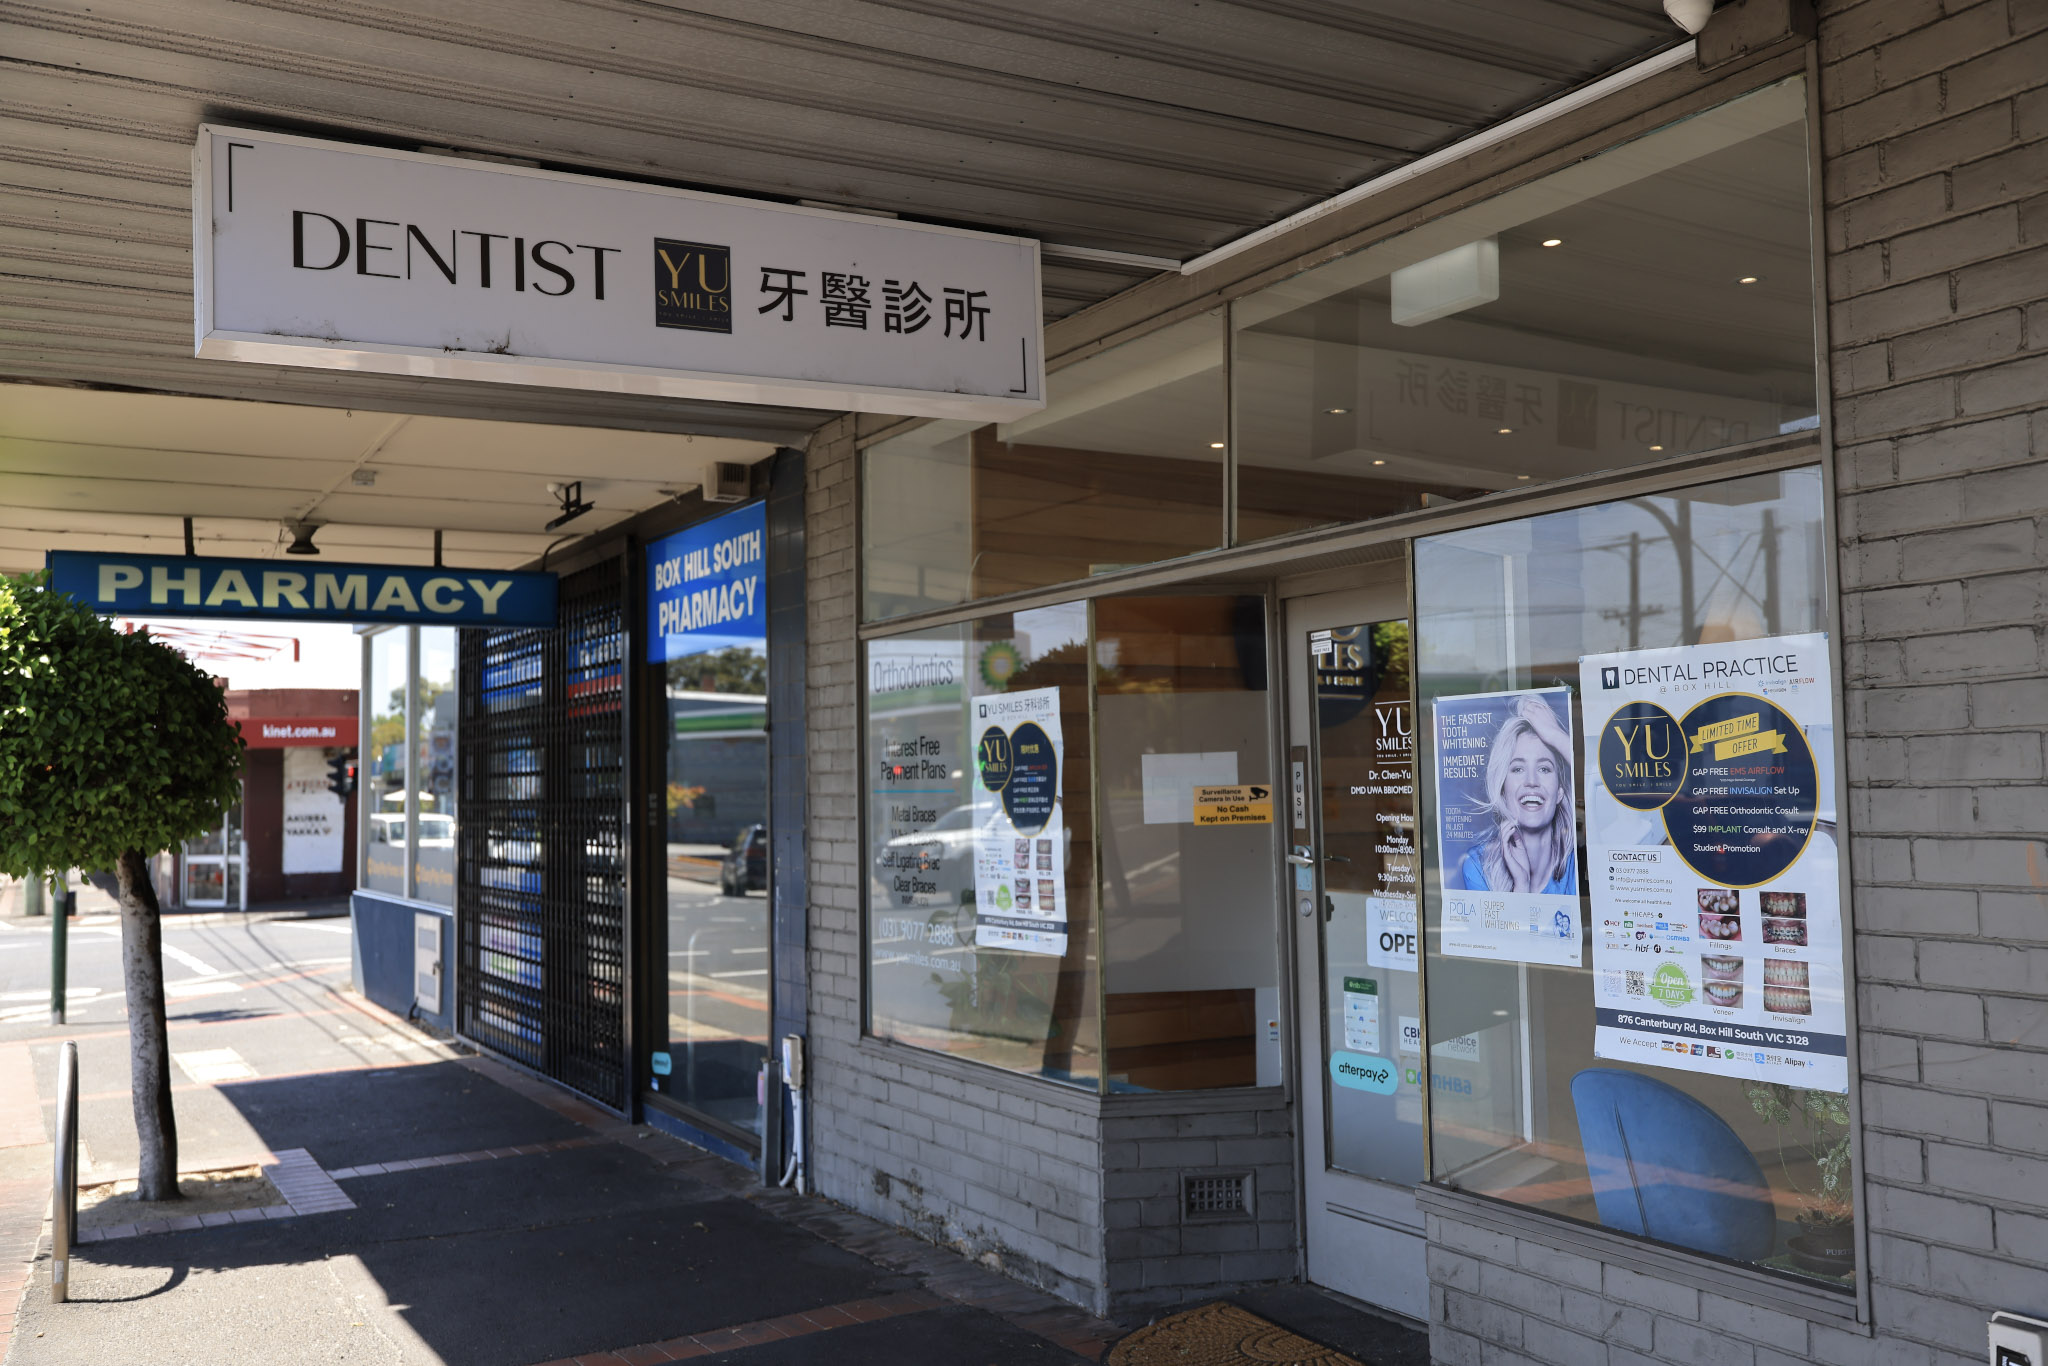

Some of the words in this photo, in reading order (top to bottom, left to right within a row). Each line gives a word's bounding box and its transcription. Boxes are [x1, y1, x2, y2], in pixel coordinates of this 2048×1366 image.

[293, 210, 621, 300] DENTIST
[657, 248, 728, 293] YU
[658, 289, 729, 313] SMILES
[758, 266, 991, 342] 牙醫診所
[655, 557, 681, 591] BOX
[684, 548, 710, 581] HILL
[713, 529, 760, 573] SOUTH
[99, 564, 513, 615] PHARMACY
[659, 575, 757, 638] PHARMACY
[874, 652, 954, 693] Orthodontics
[1624, 663, 1698, 685] DENTAL
[1703, 654, 1798, 679] PRACTICE
[1675, 684, 1697, 692] BOX
[1704, 681, 1731, 690] HILL
[1789, 677, 1815, 685] AIRFLOW
[999, 701, 1023, 714] SMILES
[1441, 715, 1456, 726] THE
[1458, 712, 1492, 725] FASTEST
[263, 724, 336, 739] kinet.com.au
[1442, 726, 1468, 738] TOOTH
[1702, 722, 1734, 741] LIMITED
[1737, 716, 1757, 730] TIME
[885, 739, 918, 758] Interest
[920, 736, 940, 756] Free
[1442, 737, 1488, 750] WHITENING.
[1613, 724, 1670, 761] YU
[1732, 738, 1758, 754] OFFER
[984, 739, 1007, 763] YU
[1443, 754, 1485, 767] IMMEDIATE
[880, 761, 919, 784] Payment
[922, 760, 946, 780] Plans
[985, 762, 1007, 773] SMILES
[1443, 767, 1479, 779] RESULTS.
[1615, 761, 1671, 778] SMILES
[1692, 768, 1708, 776] GAP
[1709, 767, 1728, 776] FREE
[1730, 767, 1746, 775] EMS
[1748, 766, 1785, 775] AIRFLOW
[1368, 770, 1380, 780] Dr.
[1381, 769, 1411, 780] Chen-Yu
[1351, 786, 1366, 795] DMD
[1367, 786, 1383, 794] UWA
[1383, 785, 1413, 795] BBIOMED
[1709, 787, 1728, 795] FREE
[1729, 786, 1773, 795] INVISALIGN
[1774, 786, 1786, 795] Set
[1788, 786, 1800, 796] Up
[892, 805, 910, 822] Metal
[912, 807, 936, 824] Braces
[1692, 807, 1708, 815] GAP
[1709, 806, 1728, 815] FREE
[1729, 806, 1774, 815] Orthodontic
[1775, 806, 1799, 815] Cosult
[1200, 815, 1218, 823] Kept
[1376, 813, 1400, 824] Opening
[1445, 815, 1472, 823] WHITENING
[1452, 823, 1464, 831] JUST
[1692, 825, 1707, 833] $99
[1708, 825, 1742, 833] IMPLANT
[1743, 825, 1771, 834] Consult
[1772, 826, 1786, 834] and
[1788, 826, 1809, 836] X-ray
[1386, 835, 1409, 845] Monday
[1453, 831, 1473, 839] MINUTES
[1693, 844, 1721, 852] Student
[1723, 844, 1761, 853] Promotion
[1612, 853, 1646, 861] CONTACT
[1647, 854, 1657, 862] US
[1387, 863, 1410, 875] Tuesday
[894, 876, 911, 893] Clear
[912, 878, 936, 895] Braces
[1450, 902, 1477, 916] POLA
[1483, 901, 1505, 911] SUPER
[1484, 910, 1500, 920] FAST
[879, 917, 897, 940] (03)
[901, 920, 925, 942] 9077
[928, 923, 954, 947] 2888
[1484, 920, 1520, 931] WHITENING
[1380, 932, 1416, 954] OPE
[1709, 941, 1732, 951] Fillings
[1774, 946, 1796, 954] Braces
[1659, 972, 1684, 988] Open
[1659, 988, 1663, 997] 7
[1665, 988, 1685, 1000] DAYS
[1772, 1014, 1806, 1024] Invisalign
[1617, 1014, 1634, 1025] 876
[1634, 1016, 1683, 1033] Canterbury
[1686, 1023, 1698, 1035] Rd,
[1699, 1025, 1717, 1035] Box
[1718, 1026, 1733, 1037] Hill
[1734, 1028, 1764, 1041] South
[1766, 1033, 1784, 1043] VIC
[1786, 1035, 1809, 1046] 3128
[1619, 1036, 1632, 1045] We
[1633, 1037, 1658, 1049] Accept
[1448, 1044, 1476, 1055] network
[1339, 1062, 1377, 1083] afterpay
